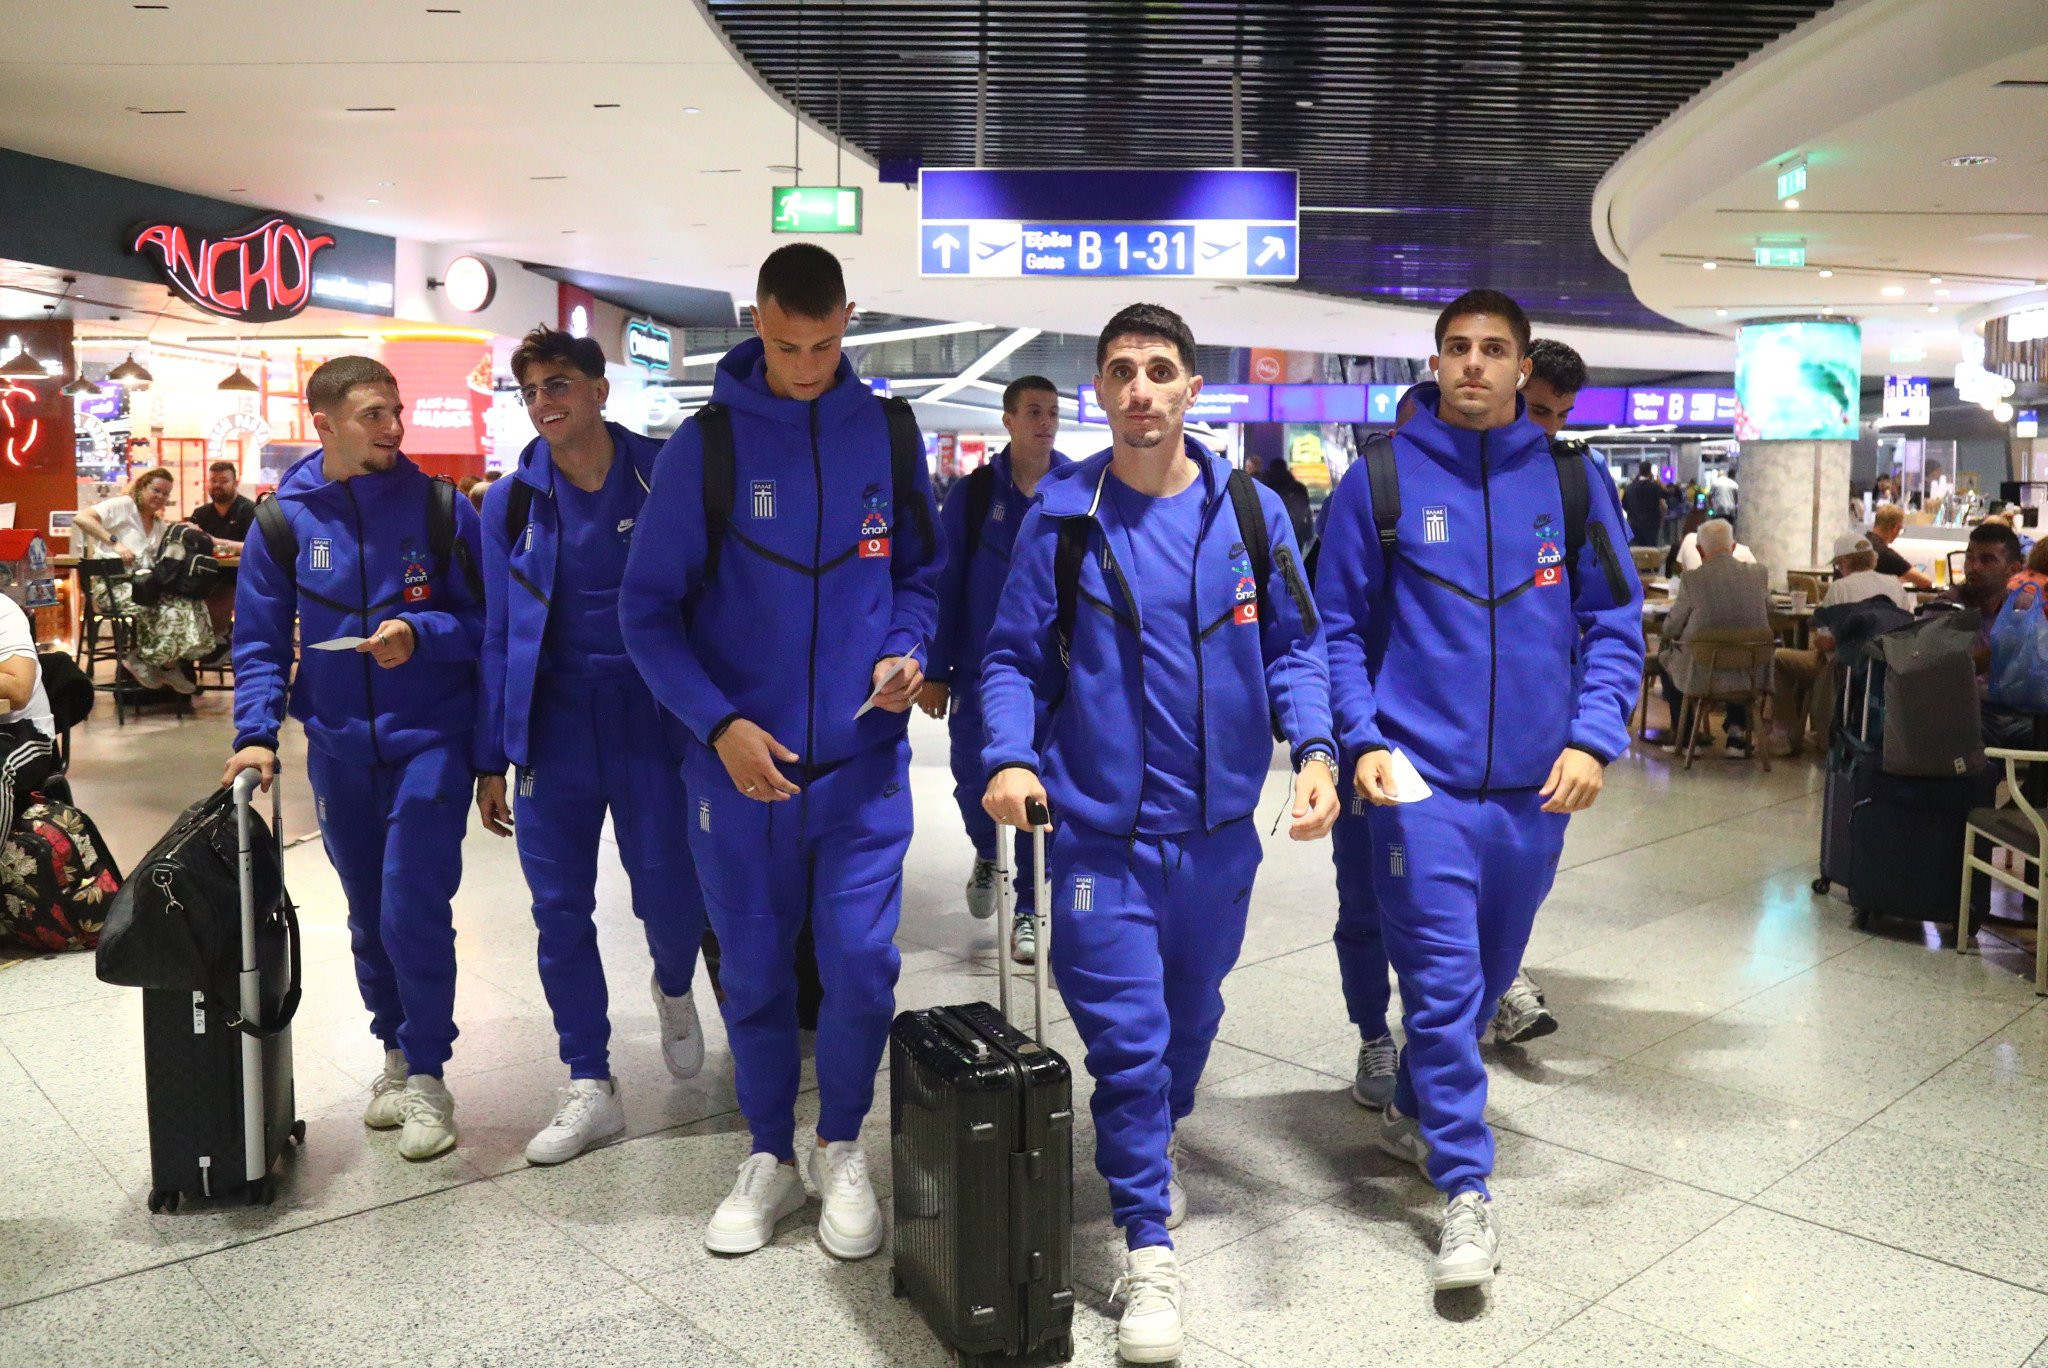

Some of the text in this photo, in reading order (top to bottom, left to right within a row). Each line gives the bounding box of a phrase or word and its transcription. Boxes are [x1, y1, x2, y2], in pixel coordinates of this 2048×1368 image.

[1078, 231, 1186, 270] B 1-31
[1668, 393, 1684, 421] B
